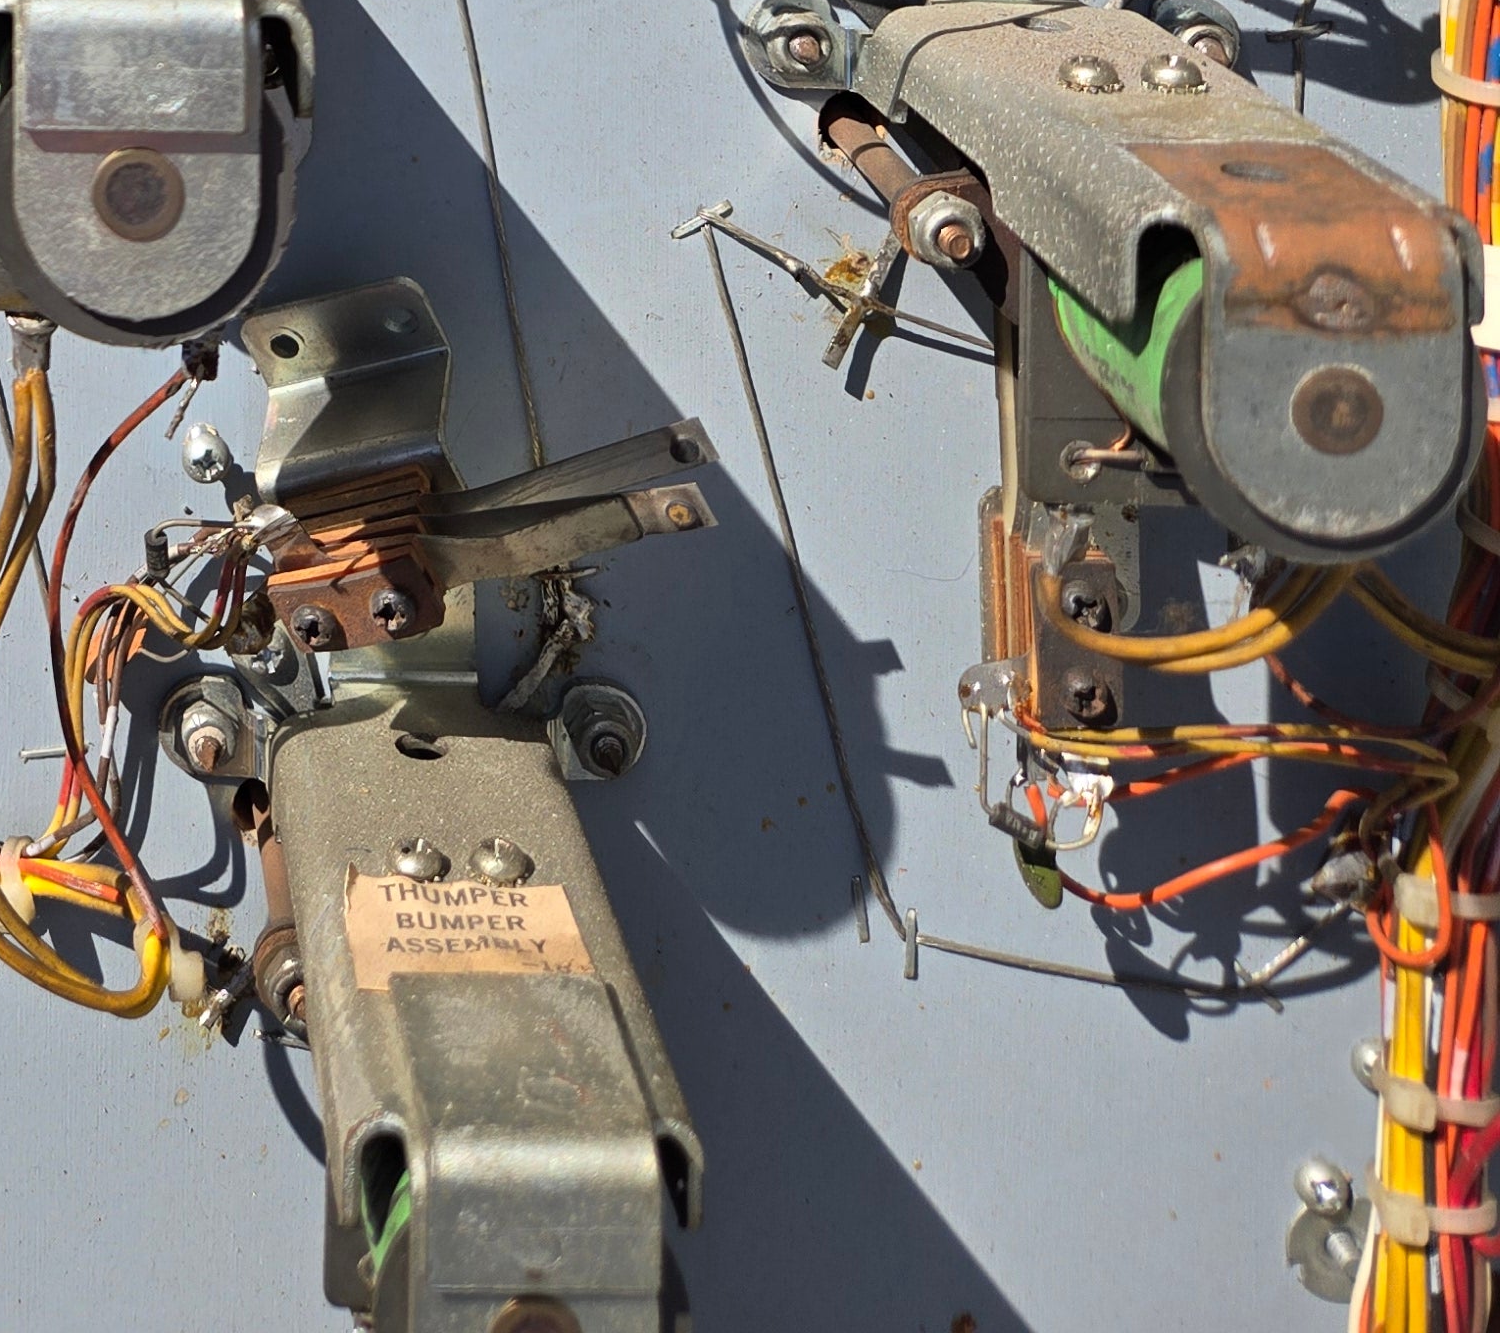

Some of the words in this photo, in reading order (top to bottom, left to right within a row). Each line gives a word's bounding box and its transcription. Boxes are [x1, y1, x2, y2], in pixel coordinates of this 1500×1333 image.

[378, 883, 529, 907] THUMPER
[396, 911, 527, 931] BUMPER
[386, 935, 546, 954] ASSEMBLY
